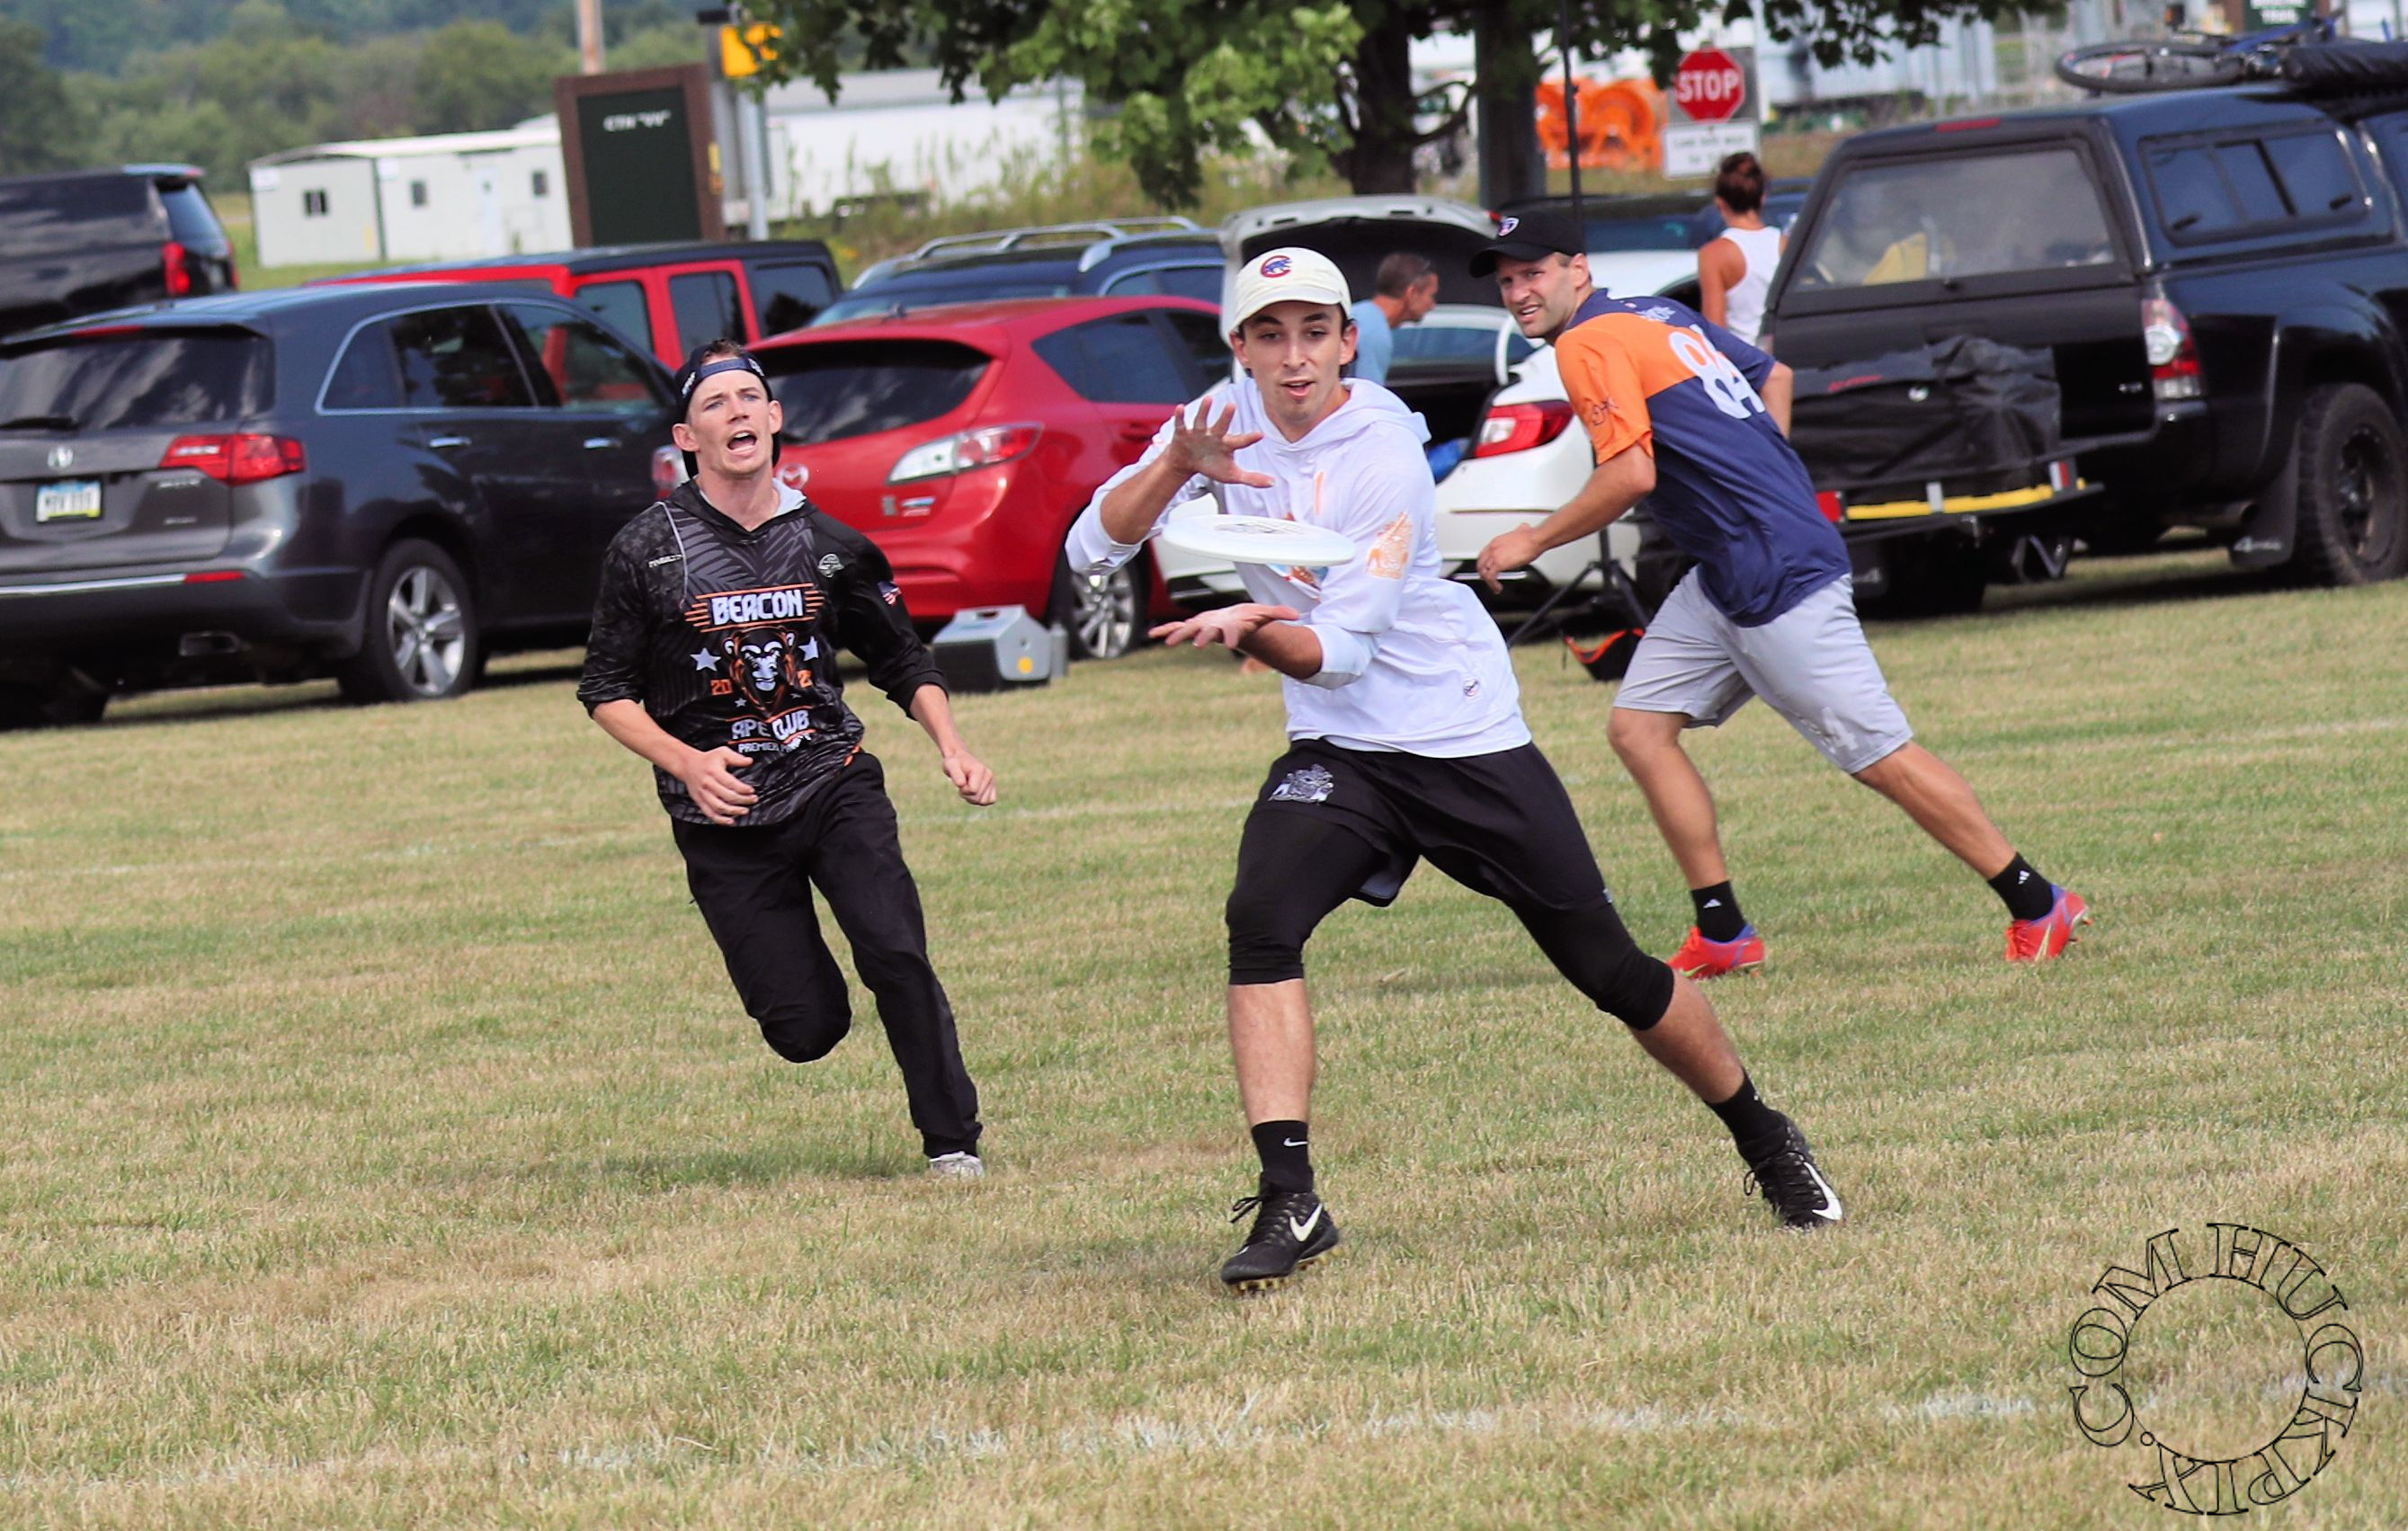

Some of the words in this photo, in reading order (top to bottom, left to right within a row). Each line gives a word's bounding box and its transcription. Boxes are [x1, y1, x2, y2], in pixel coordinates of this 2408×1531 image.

[1678, 67, 1739, 102] STOP
[712, 589, 803, 626] BEACON
[771, 709, 810, 741] CLUB
